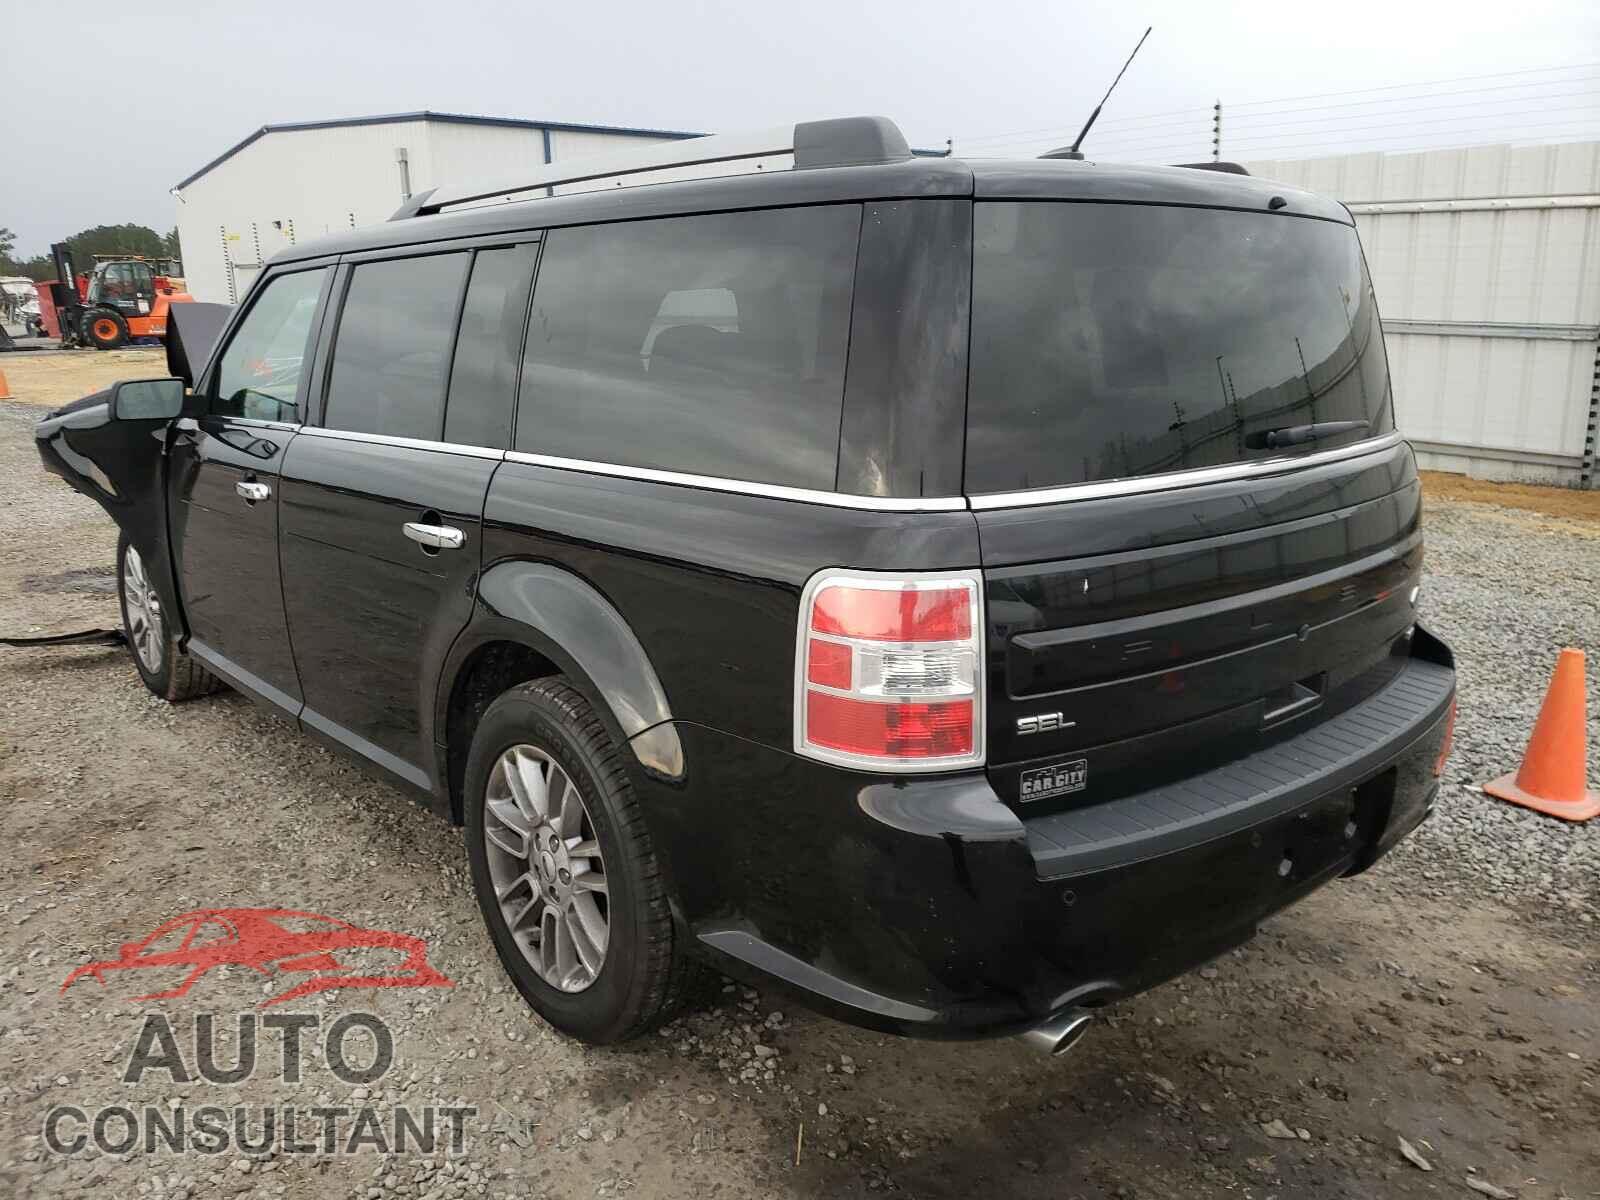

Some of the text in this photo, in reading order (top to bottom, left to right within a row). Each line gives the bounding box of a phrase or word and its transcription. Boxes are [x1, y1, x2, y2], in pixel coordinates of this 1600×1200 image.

[1016, 711, 1076, 735] SEL
[1022, 777, 1053, 795] CAR
[1055, 769, 1085, 788] CITY
